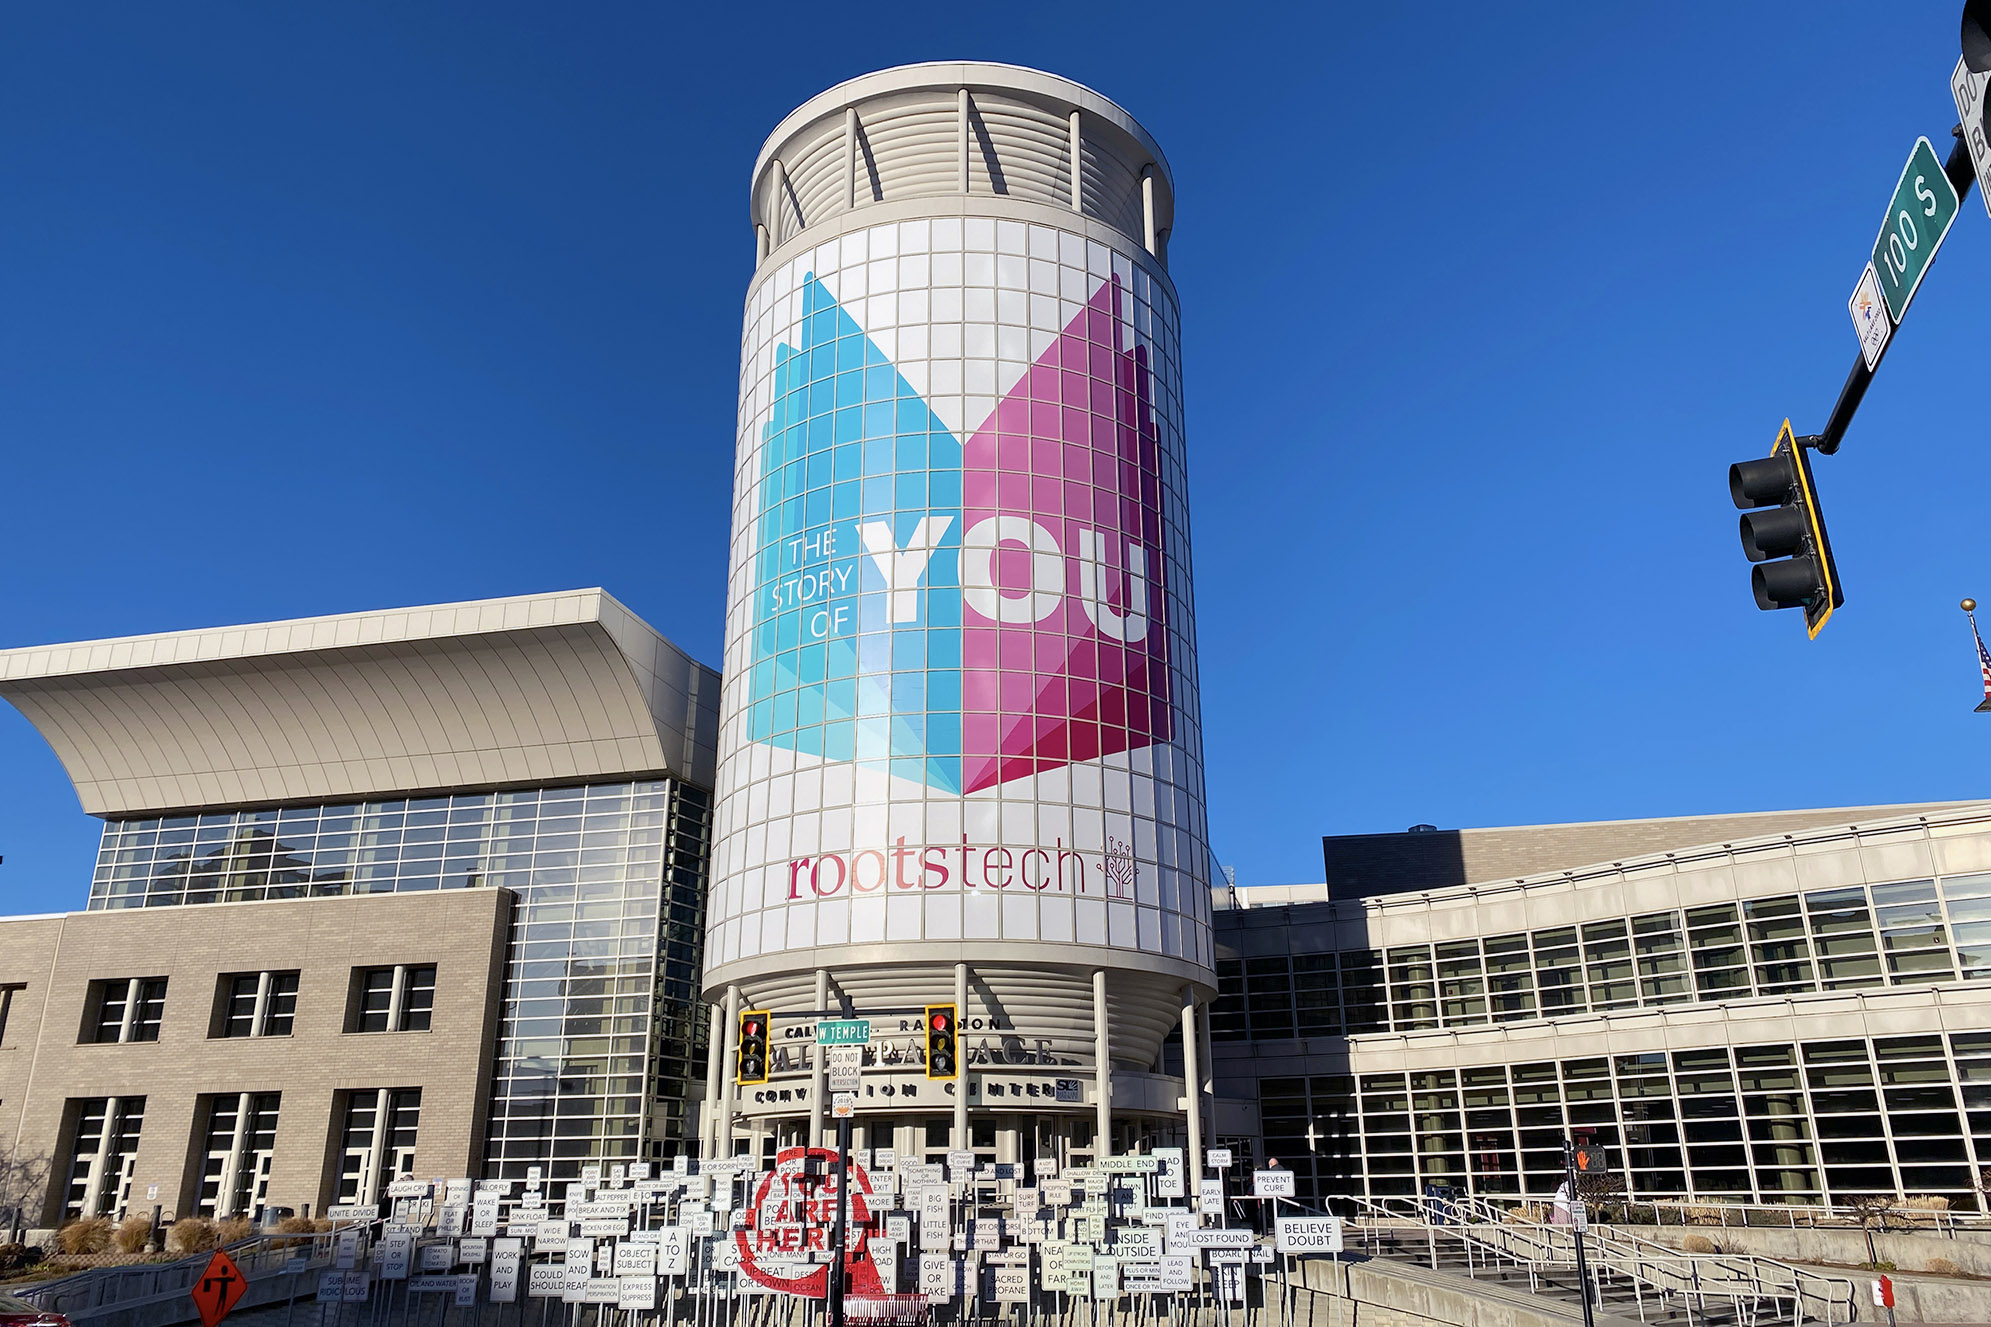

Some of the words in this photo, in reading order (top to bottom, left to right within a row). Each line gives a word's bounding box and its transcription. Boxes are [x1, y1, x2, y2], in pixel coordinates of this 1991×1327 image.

[1959, 70, 1978, 117] DO
[1884, 210, 1918, 287] 100
[1915, 175, 1937, 217] S
[789, 529, 837, 566] THE
[855, 516, 1149, 643] YOU
[772, 565, 854, 612] STORY
[810, 606, 848, 639] OF
[785, 832, 1085, 900] rootstech
[900, 1018, 1001, 1032] RATON
[819, 1029, 827, 1040] W
[831, 1026, 868, 1040] TEMPLE
[873, 1037, 1053, 1068] PAACE
[833, 1053, 842, 1063] DO
[844, 1053, 858, 1063] NOT
[833, 1067, 858, 1077] BLOCK
[755, 1084, 917, 1104] CONVION
[784, 1149, 797, 1157] PRE
[1100, 1160, 1132, 1169] MIDDLE
[1136, 1160, 1155, 1168] END
[780, 1167, 800, 1175] POST
[1159, 1180, 1177, 1188] TOE
[1256, 1175, 1291, 1184] PREVENT
[390, 1185, 412, 1193] LAUGH
[413, 1184, 426, 1192] CRY
[1263, 1184, 1285, 1192] CURE
[928, 1194, 942, 1203] BIG
[1018, 1193, 1034, 1201] SURF
[329, 1209, 350, 1218] UNITE
[352, 1208, 376, 1217] DIVIDE
[480, 1209, 490, 1217] OR
[578, 1206, 600, 1214] BREAK
[926, 1205, 943, 1213] FISH
[735, 1212, 754, 1220] ODD
[922, 1220, 947, 1229] LITTLE
[1175, 1221, 1190, 1229] EYE
[1284, 1223, 1333, 1234] BELIEVE
[543, 1227, 561, 1235] WIDE
[926, 1231, 943, 1239] FISH
[1021, 1227, 1054, 1235] BOTTOM
[537, 1237, 566, 1245] NARROW
[669, 1232, 677, 1242] A
[1112, 1233, 1149, 1244] INSIDE
[1191, 1234, 1214, 1243] LOST
[1215, 1234, 1250, 1243] FOUND
[1287, 1235, 1331, 1246] DOUBT
[665, 1245, 680, 1256] TO
[731, 1243, 763, 1254] STICK
[871, 1246, 892, 1254] HIGH
[1106, 1245, 1156, 1258] OUTSIDE
[495, 1252, 518, 1260] WORK
[568, 1249, 590, 1259] SOW
[619, 1249, 651, 1258] OBJECT
[769, 1251, 785, 1259] ONE
[786, 1251, 807, 1259] MANY
[1250, 1250, 1270, 1258] NAIL
[385, 1263, 404, 1271] STOP
[616, 1260, 652, 1269] SUBJECT
[668, 1259, 675, 1269] Z
[923, 1260, 945, 1270] GIVE
[495, 1266, 513, 1274] AND
[533, 1270, 563, 1279] COULD
[568, 1265, 588, 1275] AND
[745, 1267, 759, 1278] UP
[760, 1267, 785, 1277] BEAT
[794, 1270, 823, 1279] DESERT
[871, 1276, 891, 1285] LOW
[927, 1274, 942, 1283] OR
[989, 1275, 1024, 1284] SACRED
[1047, 1274, 1067, 1284] FAR
[494, 1281, 513, 1289] PLAY
[530, 1281, 563, 1290] SHOULD
[565, 1281, 587, 1291] REAP
[622, 1283, 652, 1291] EXPRESS
[739, 1278, 754, 1289] OR
[756, 1278, 790, 1289] DOWN
[793, 1283, 822, 1292] OCEAN
[922, 1287, 946, 1297] TAKE
[987, 1286, 1027, 1295] PROFANE
